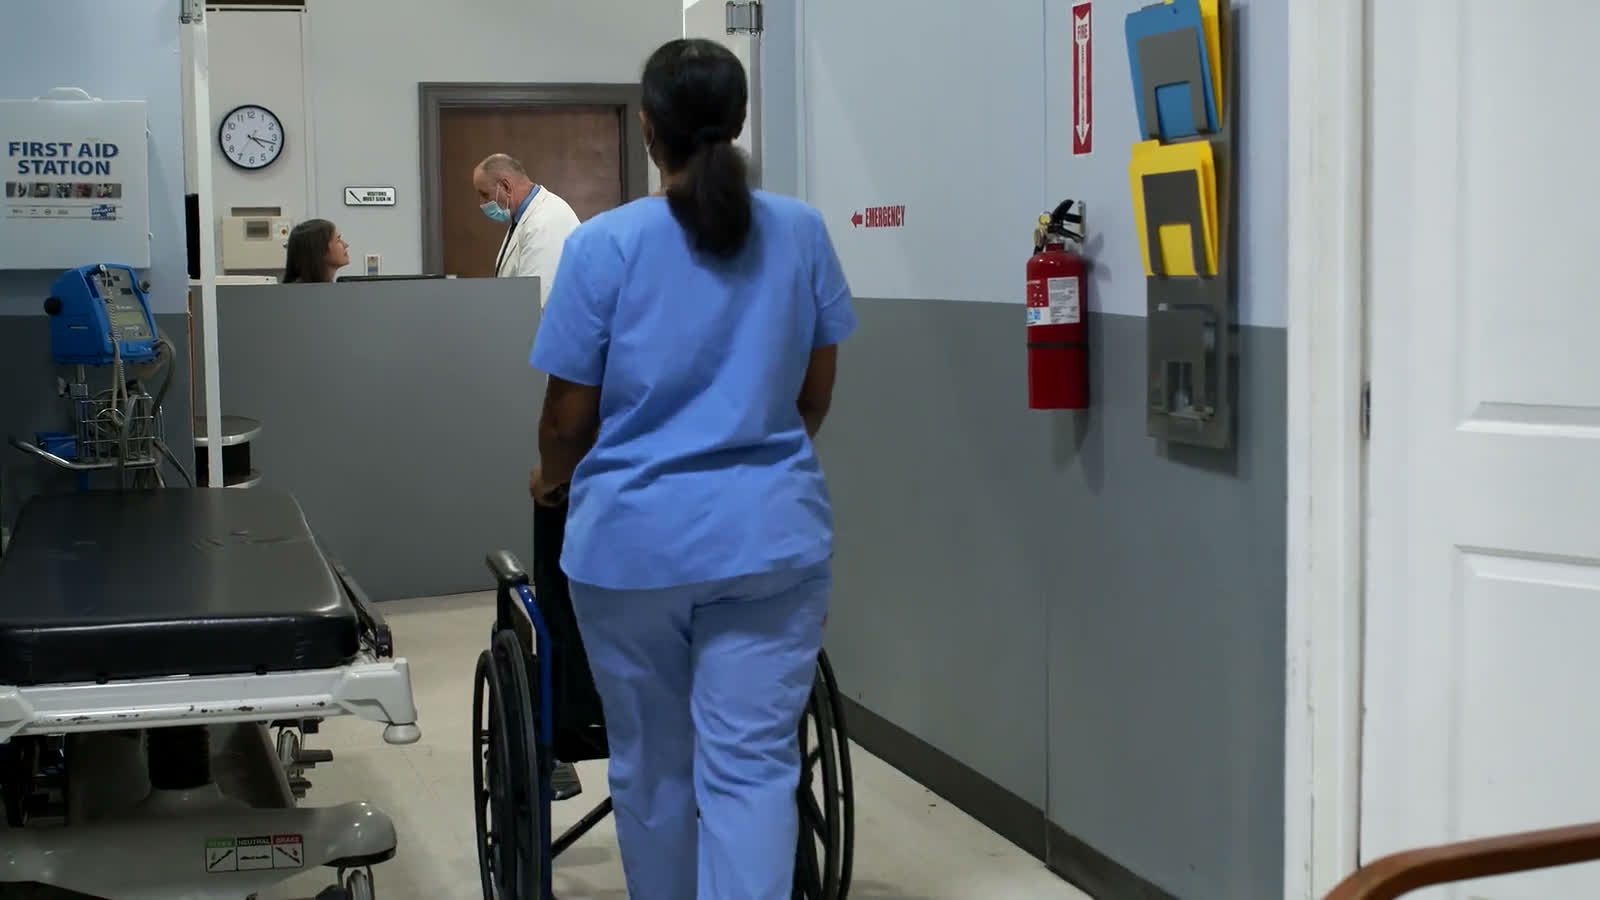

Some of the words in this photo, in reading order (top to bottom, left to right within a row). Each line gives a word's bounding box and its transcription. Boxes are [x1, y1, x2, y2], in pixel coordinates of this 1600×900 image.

[1077, 23, 1088, 40] FIRE
[8, 142, 72, 157] FIRST
[78, 143, 119, 158] AID
[17, 160, 111, 175] STATION
[865, 205, 905, 228] EMERGENCY
